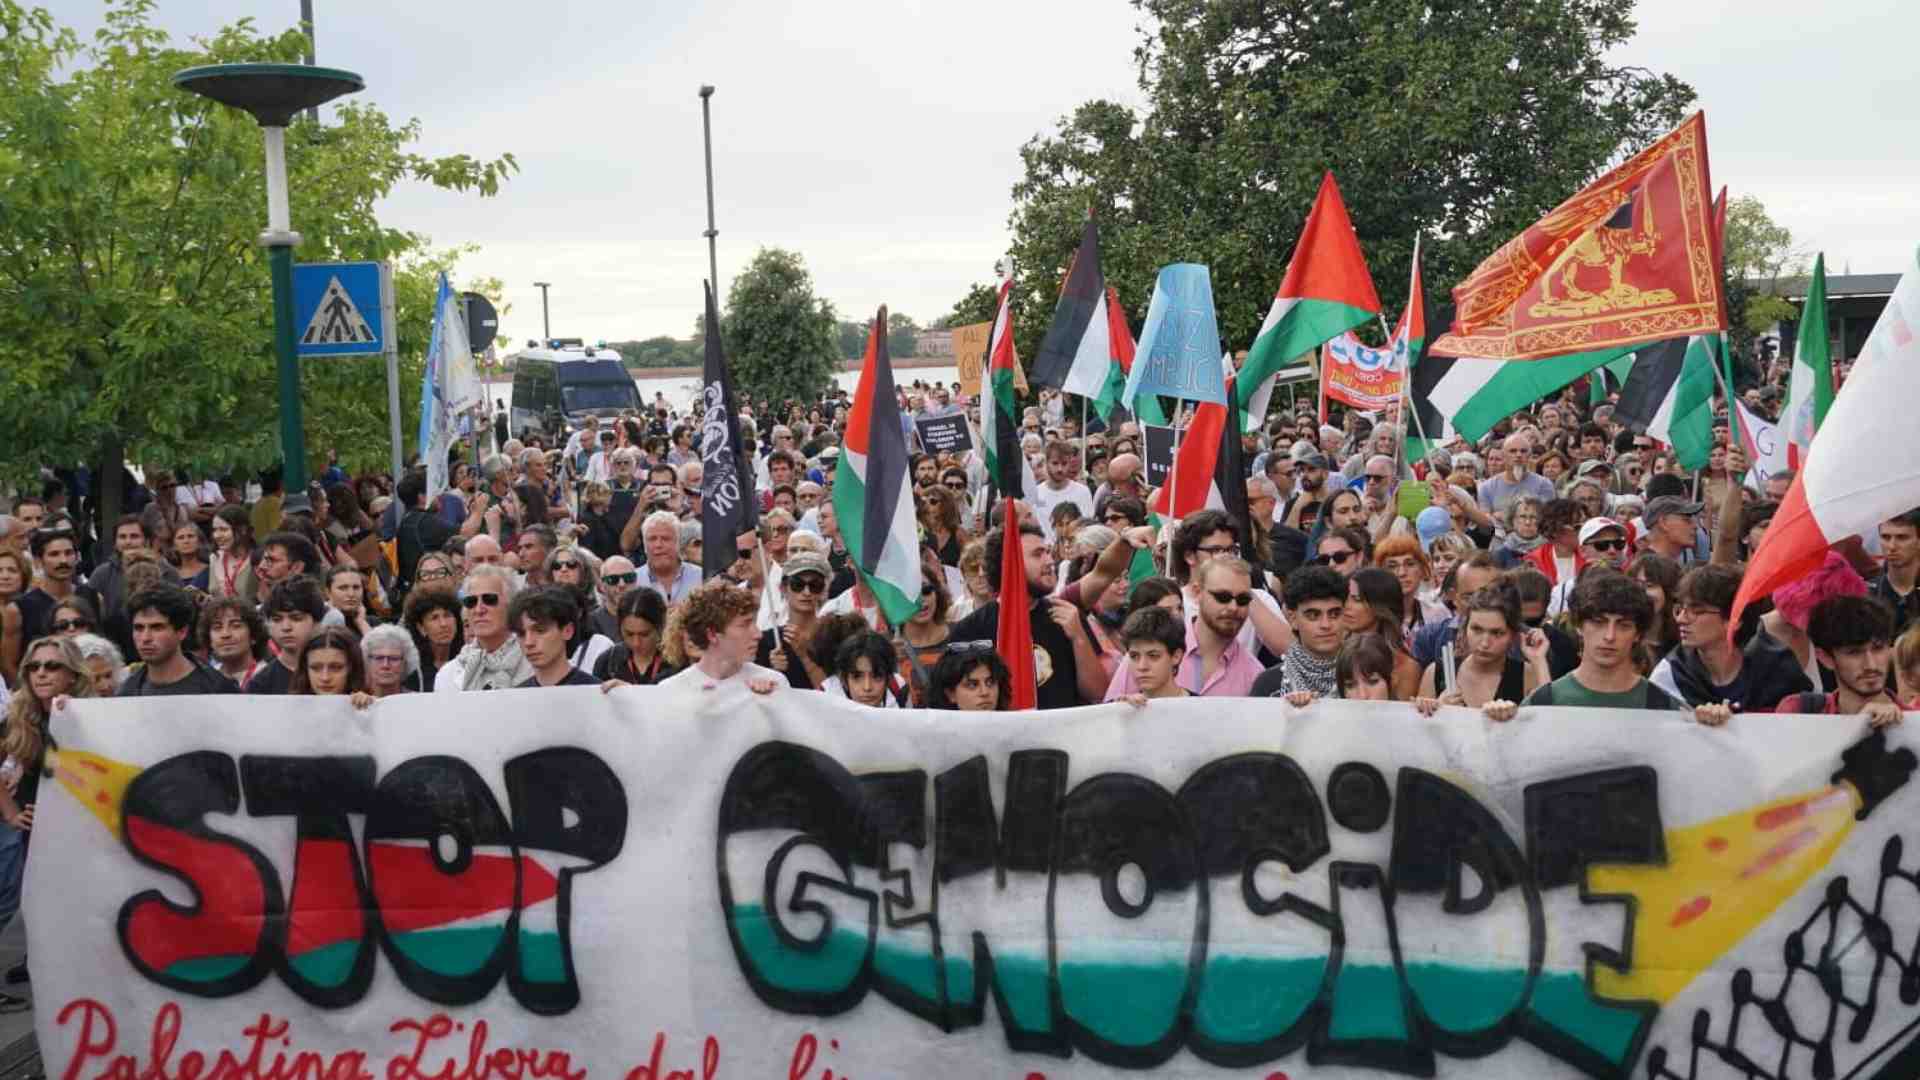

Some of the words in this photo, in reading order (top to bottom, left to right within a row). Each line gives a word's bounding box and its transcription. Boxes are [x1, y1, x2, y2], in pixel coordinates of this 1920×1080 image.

[117, 746, 628, 1016] STOP
[56, 998, 373, 1080] Palestina
[387, 1013, 587, 1080] Libera
